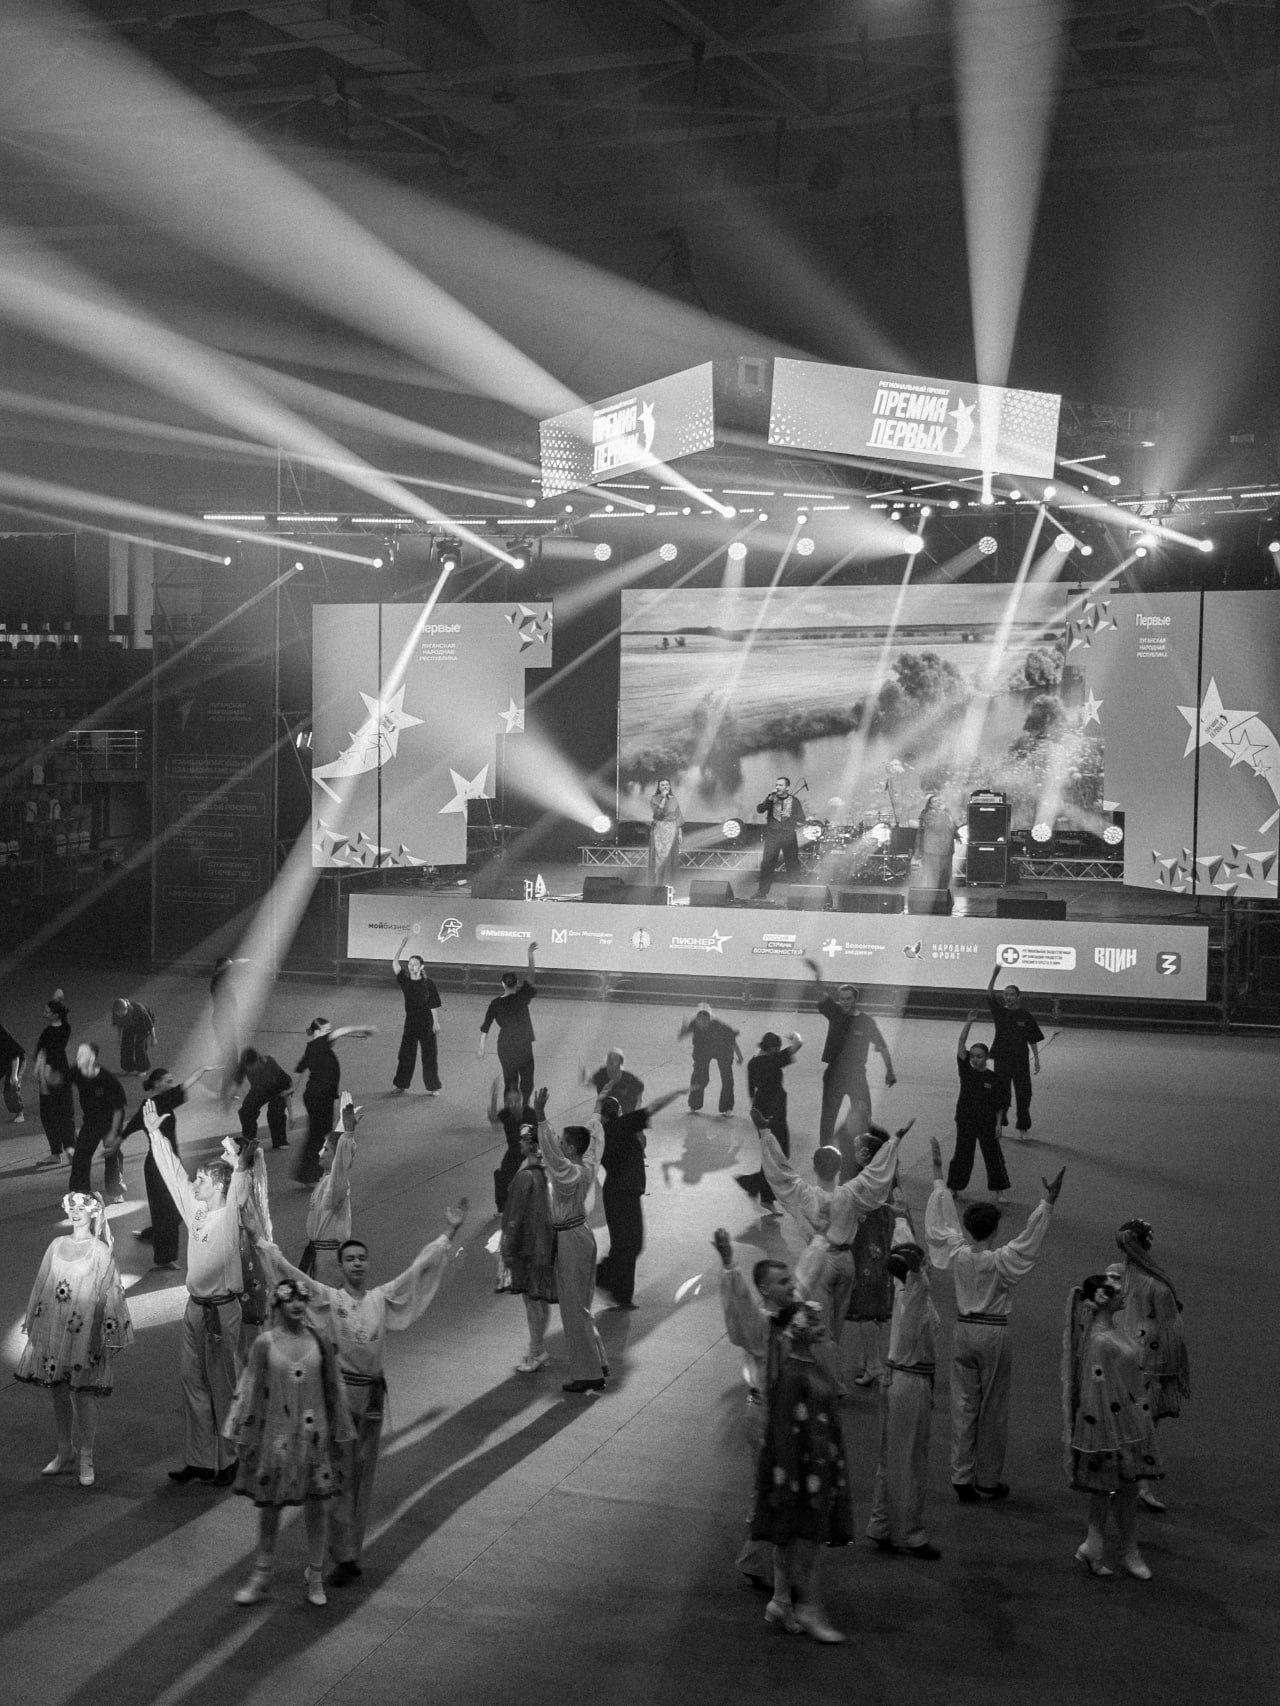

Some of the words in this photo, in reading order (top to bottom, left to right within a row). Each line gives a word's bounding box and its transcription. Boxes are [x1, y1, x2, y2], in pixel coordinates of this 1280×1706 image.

[872, 389, 949, 422] ПРЕМИЯ
[870, 418, 948, 451] ПЕРВЫХ
[1135, 613, 1172, 629] Первые
[480, 929, 532, 938] #МЫВМЕСТЕ
[672, 937, 716, 946] ПИОНЕР
[932, 944, 978, 953] НАРОДНЫЙ
[932, 952, 960, 960] ФРОНТ
[1094, 948, 1137, 973] ВОИН
